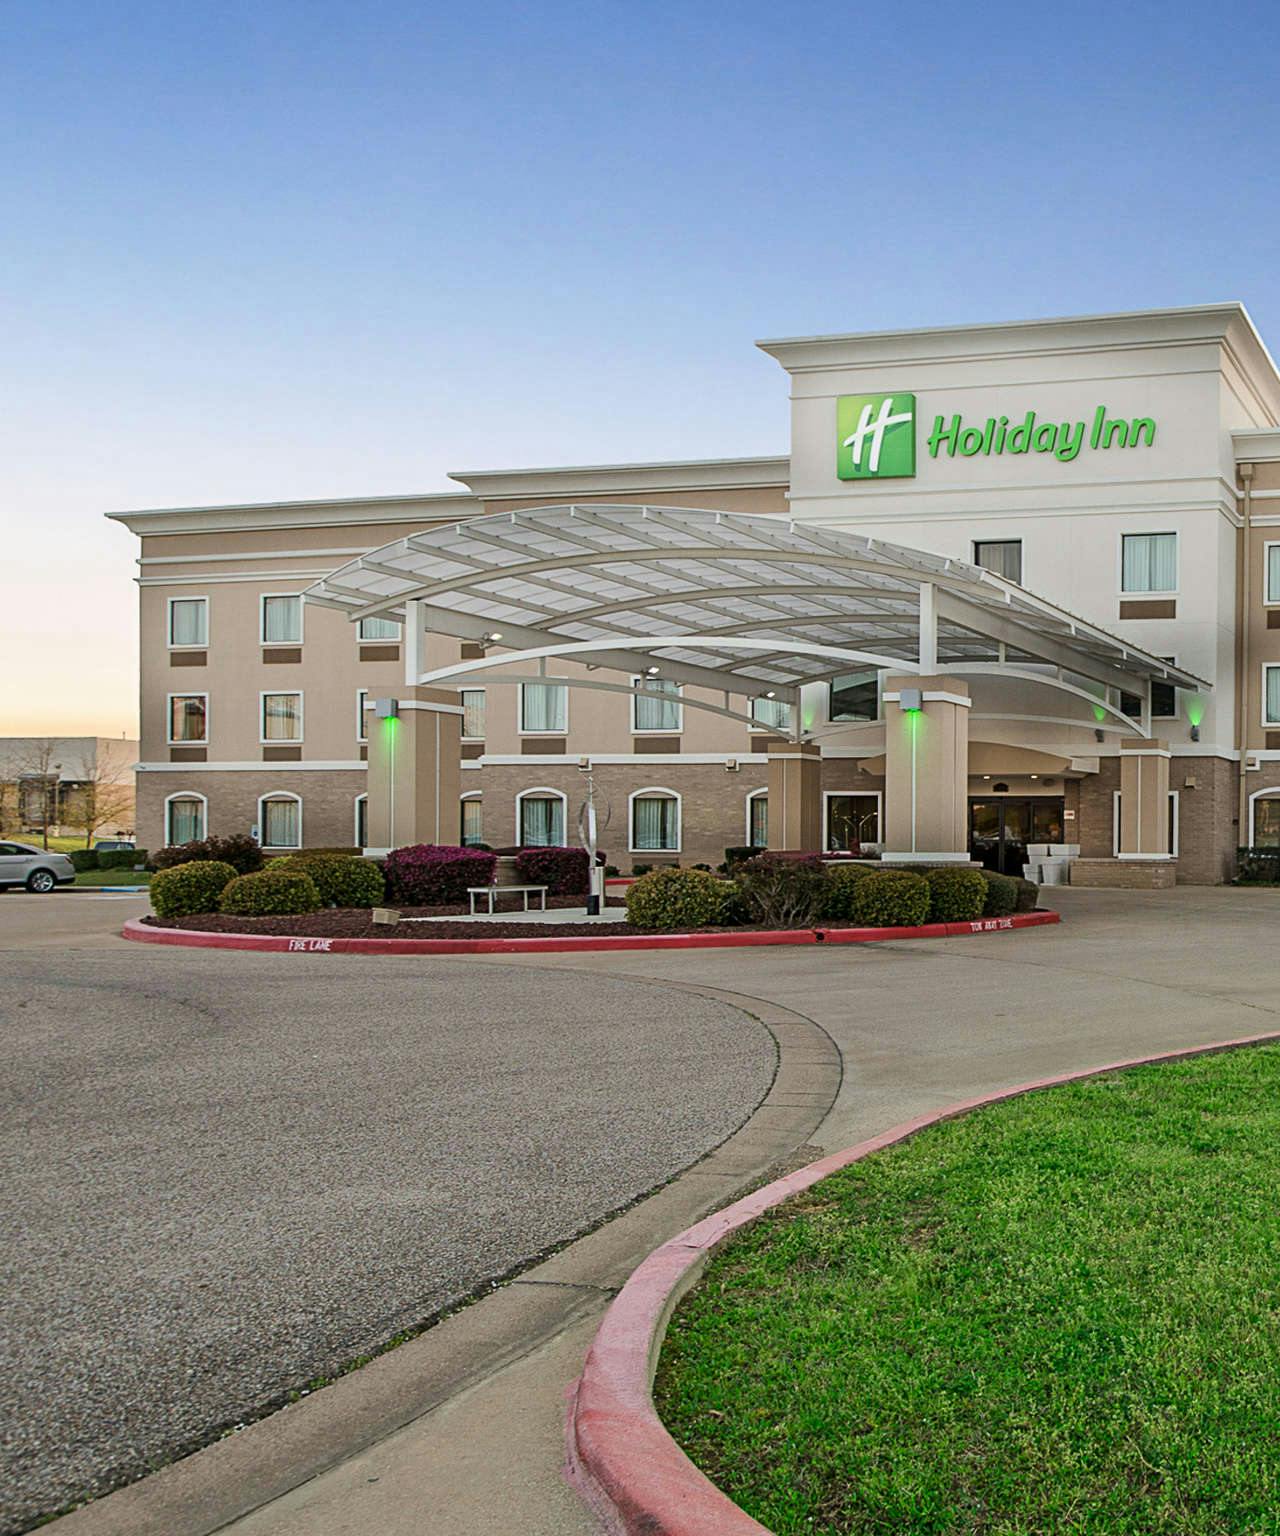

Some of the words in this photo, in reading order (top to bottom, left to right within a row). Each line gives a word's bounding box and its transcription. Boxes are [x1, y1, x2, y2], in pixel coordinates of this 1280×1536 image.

[927, 411, 1085, 462] Holiday
[1090, 405, 1156, 449] Inn
[289, 939, 308, 951] FIRE
[310, 939, 333, 951] LANE
